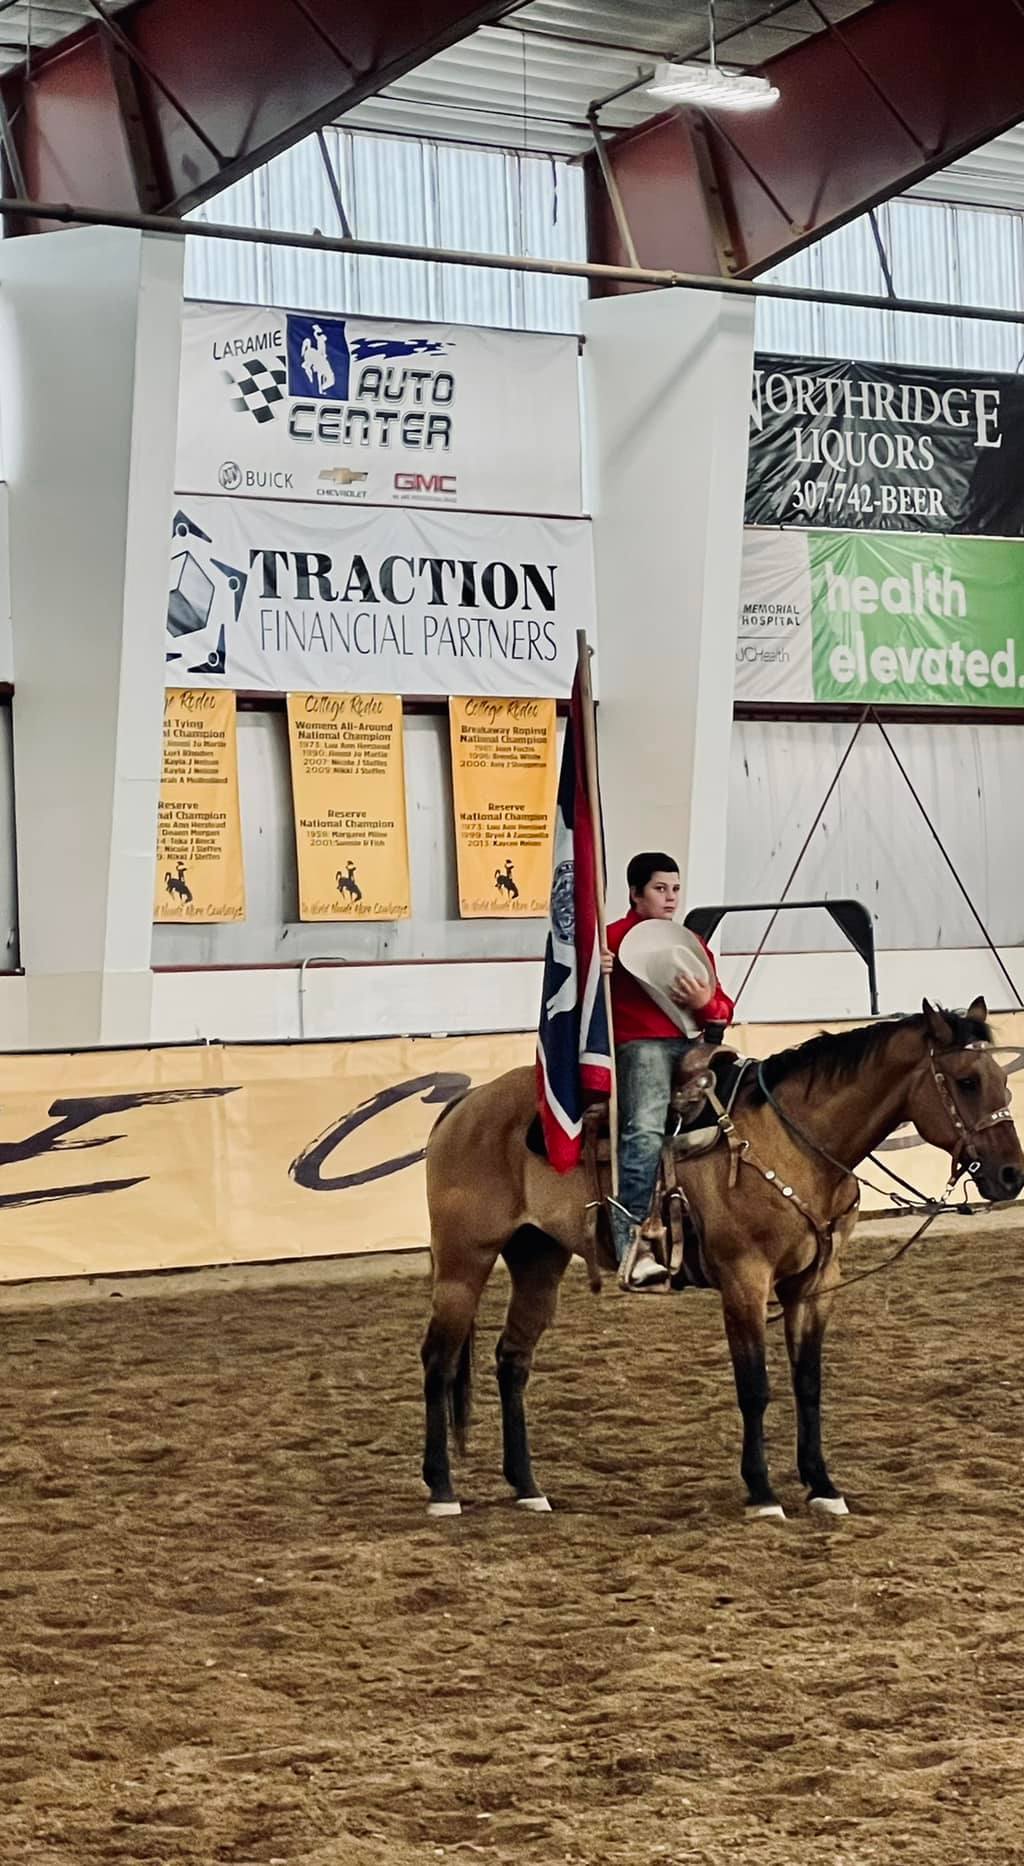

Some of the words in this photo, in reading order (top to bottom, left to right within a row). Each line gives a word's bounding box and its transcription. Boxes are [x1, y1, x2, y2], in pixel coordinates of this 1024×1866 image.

[213, 329, 283, 360] LARAMIE
[355, 365, 455, 407] AUTO
[288, 402, 453, 452] CENTER
[793, 427, 935, 473] LIQUORS
[246, 470, 294, 489] BUICK
[394, 472, 457, 494] GMC
[316, 488, 368, 499] CHEVROLET
[791, 480, 947, 517] 307-742-BEER
[249, 549, 558, 611] TRACTION
[823, 561, 967, 617] health
[743, 603, 800, 615] MEMORIAL
[742, 615, 801, 627] HOSPITAL
[260, 609, 413, 656] FINANCIAL
[423, 615, 558, 662] PARTNERS
[174, 719, 204, 729] Tying
[295, 721, 338, 729] Womens
[340, 722, 393, 731] All-Around
[173, 729, 225, 739] Champion
[298, 730, 340, 739] National
[343, 731, 391, 742] Champion
[461, 725, 510, 735] Breakaway
[512, 726, 547, 736] Roping
[460, 735, 499, 743] National
[501, 735, 548, 745] Champion
[158, 801, 199, 809] Reserve
[488, 802, 526, 811] Reserve
[175, 811, 227, 821] Champion
[327, 809, 367, 818] Reserve
[460, 812, 502, 821] National
[504, 813, 548, 822] Champion
[300, 819, 342, 828] National
[345, 820, 395, 829] Champion
